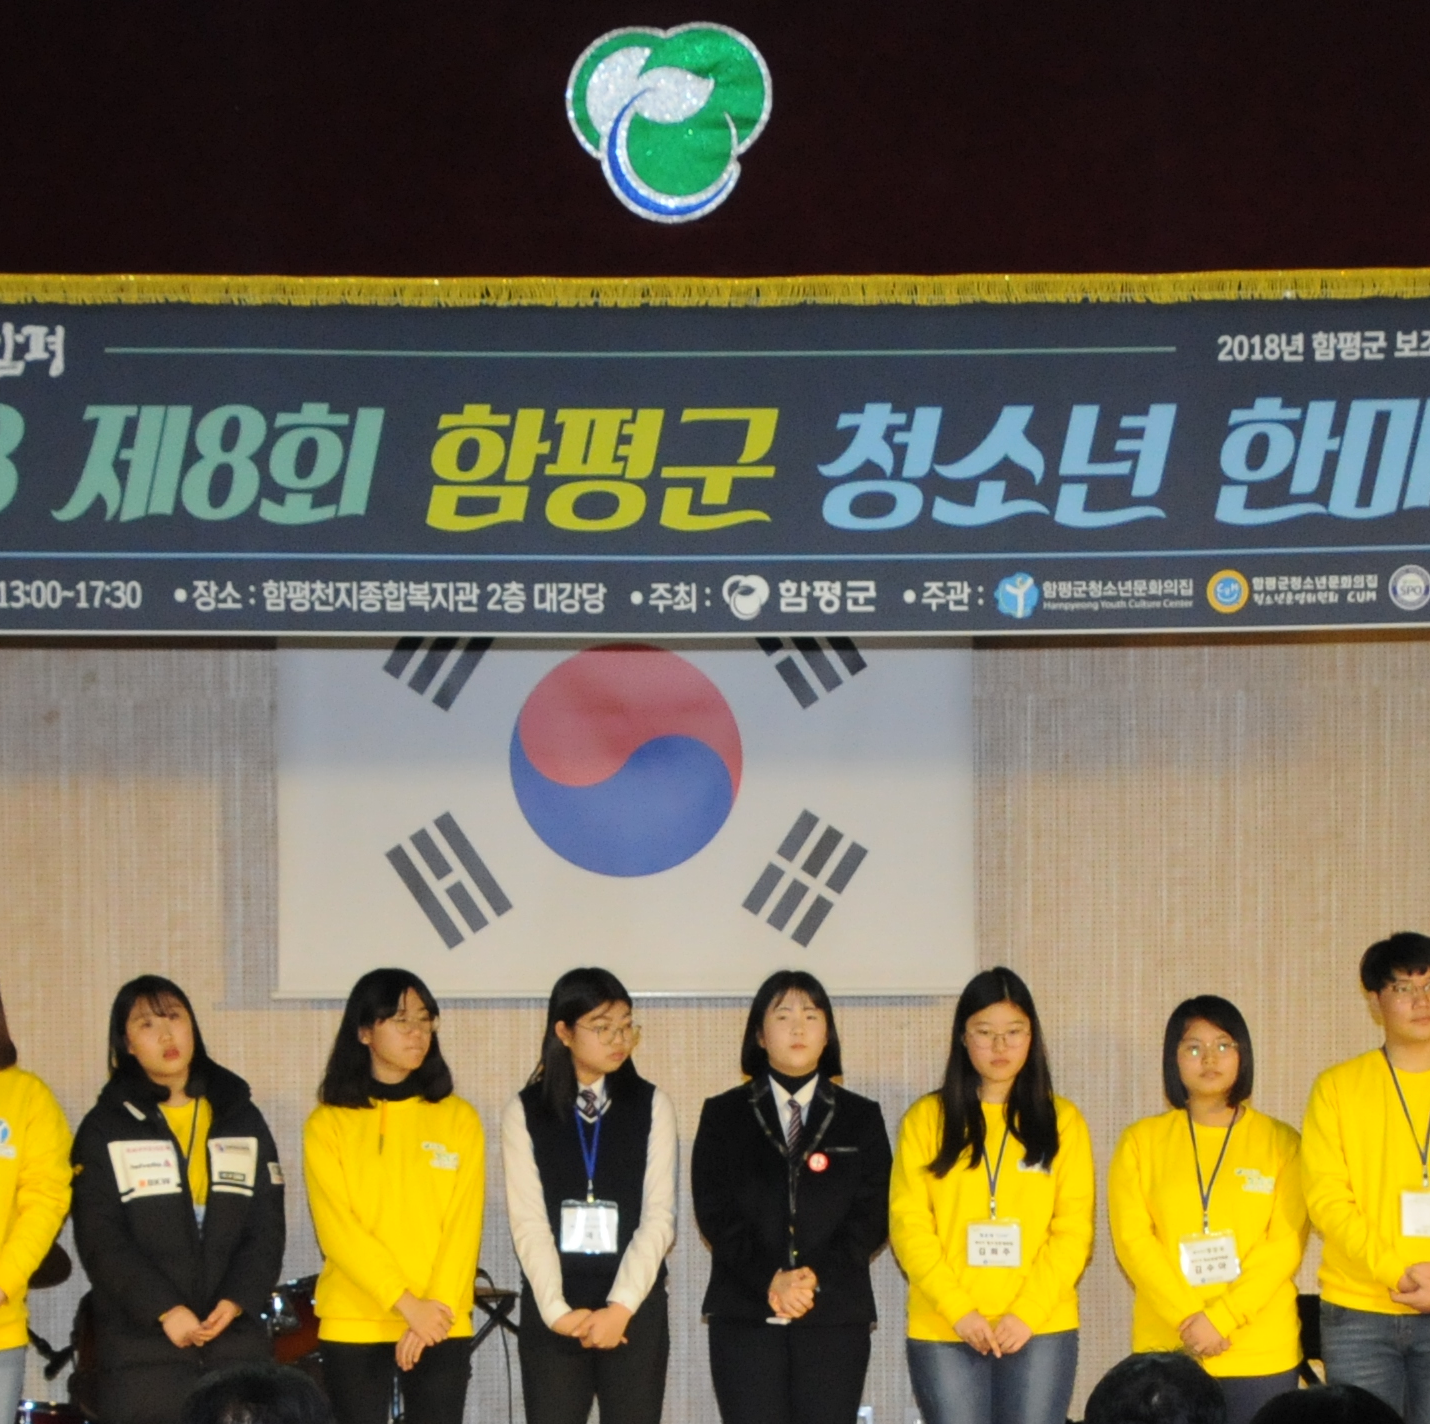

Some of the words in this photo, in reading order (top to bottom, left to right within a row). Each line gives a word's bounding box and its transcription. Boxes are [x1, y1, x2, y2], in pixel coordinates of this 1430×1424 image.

[1216, 332, 1304, 362] 2018년
[1312, 330, 1388, 361] 함평군
[51, 402, 385, 525] 제8회
[426, 403, 780, 532] 함평군
[817, 402, 1177, 531] 청소년
[192, 580, 243, 611] 장소
[262, 580, 479, 612] 함평천지종합복지관
[487, 582, 527, 613] 2층
[533, 582, 607, 614] 대강당
[648, 581, 698, 613] 주최
[778, 579, 877, 614] 함평군
[921, 581, 972, 613] 주관
[1042, 577, 1194, 598] 함평군청소년문화의집
